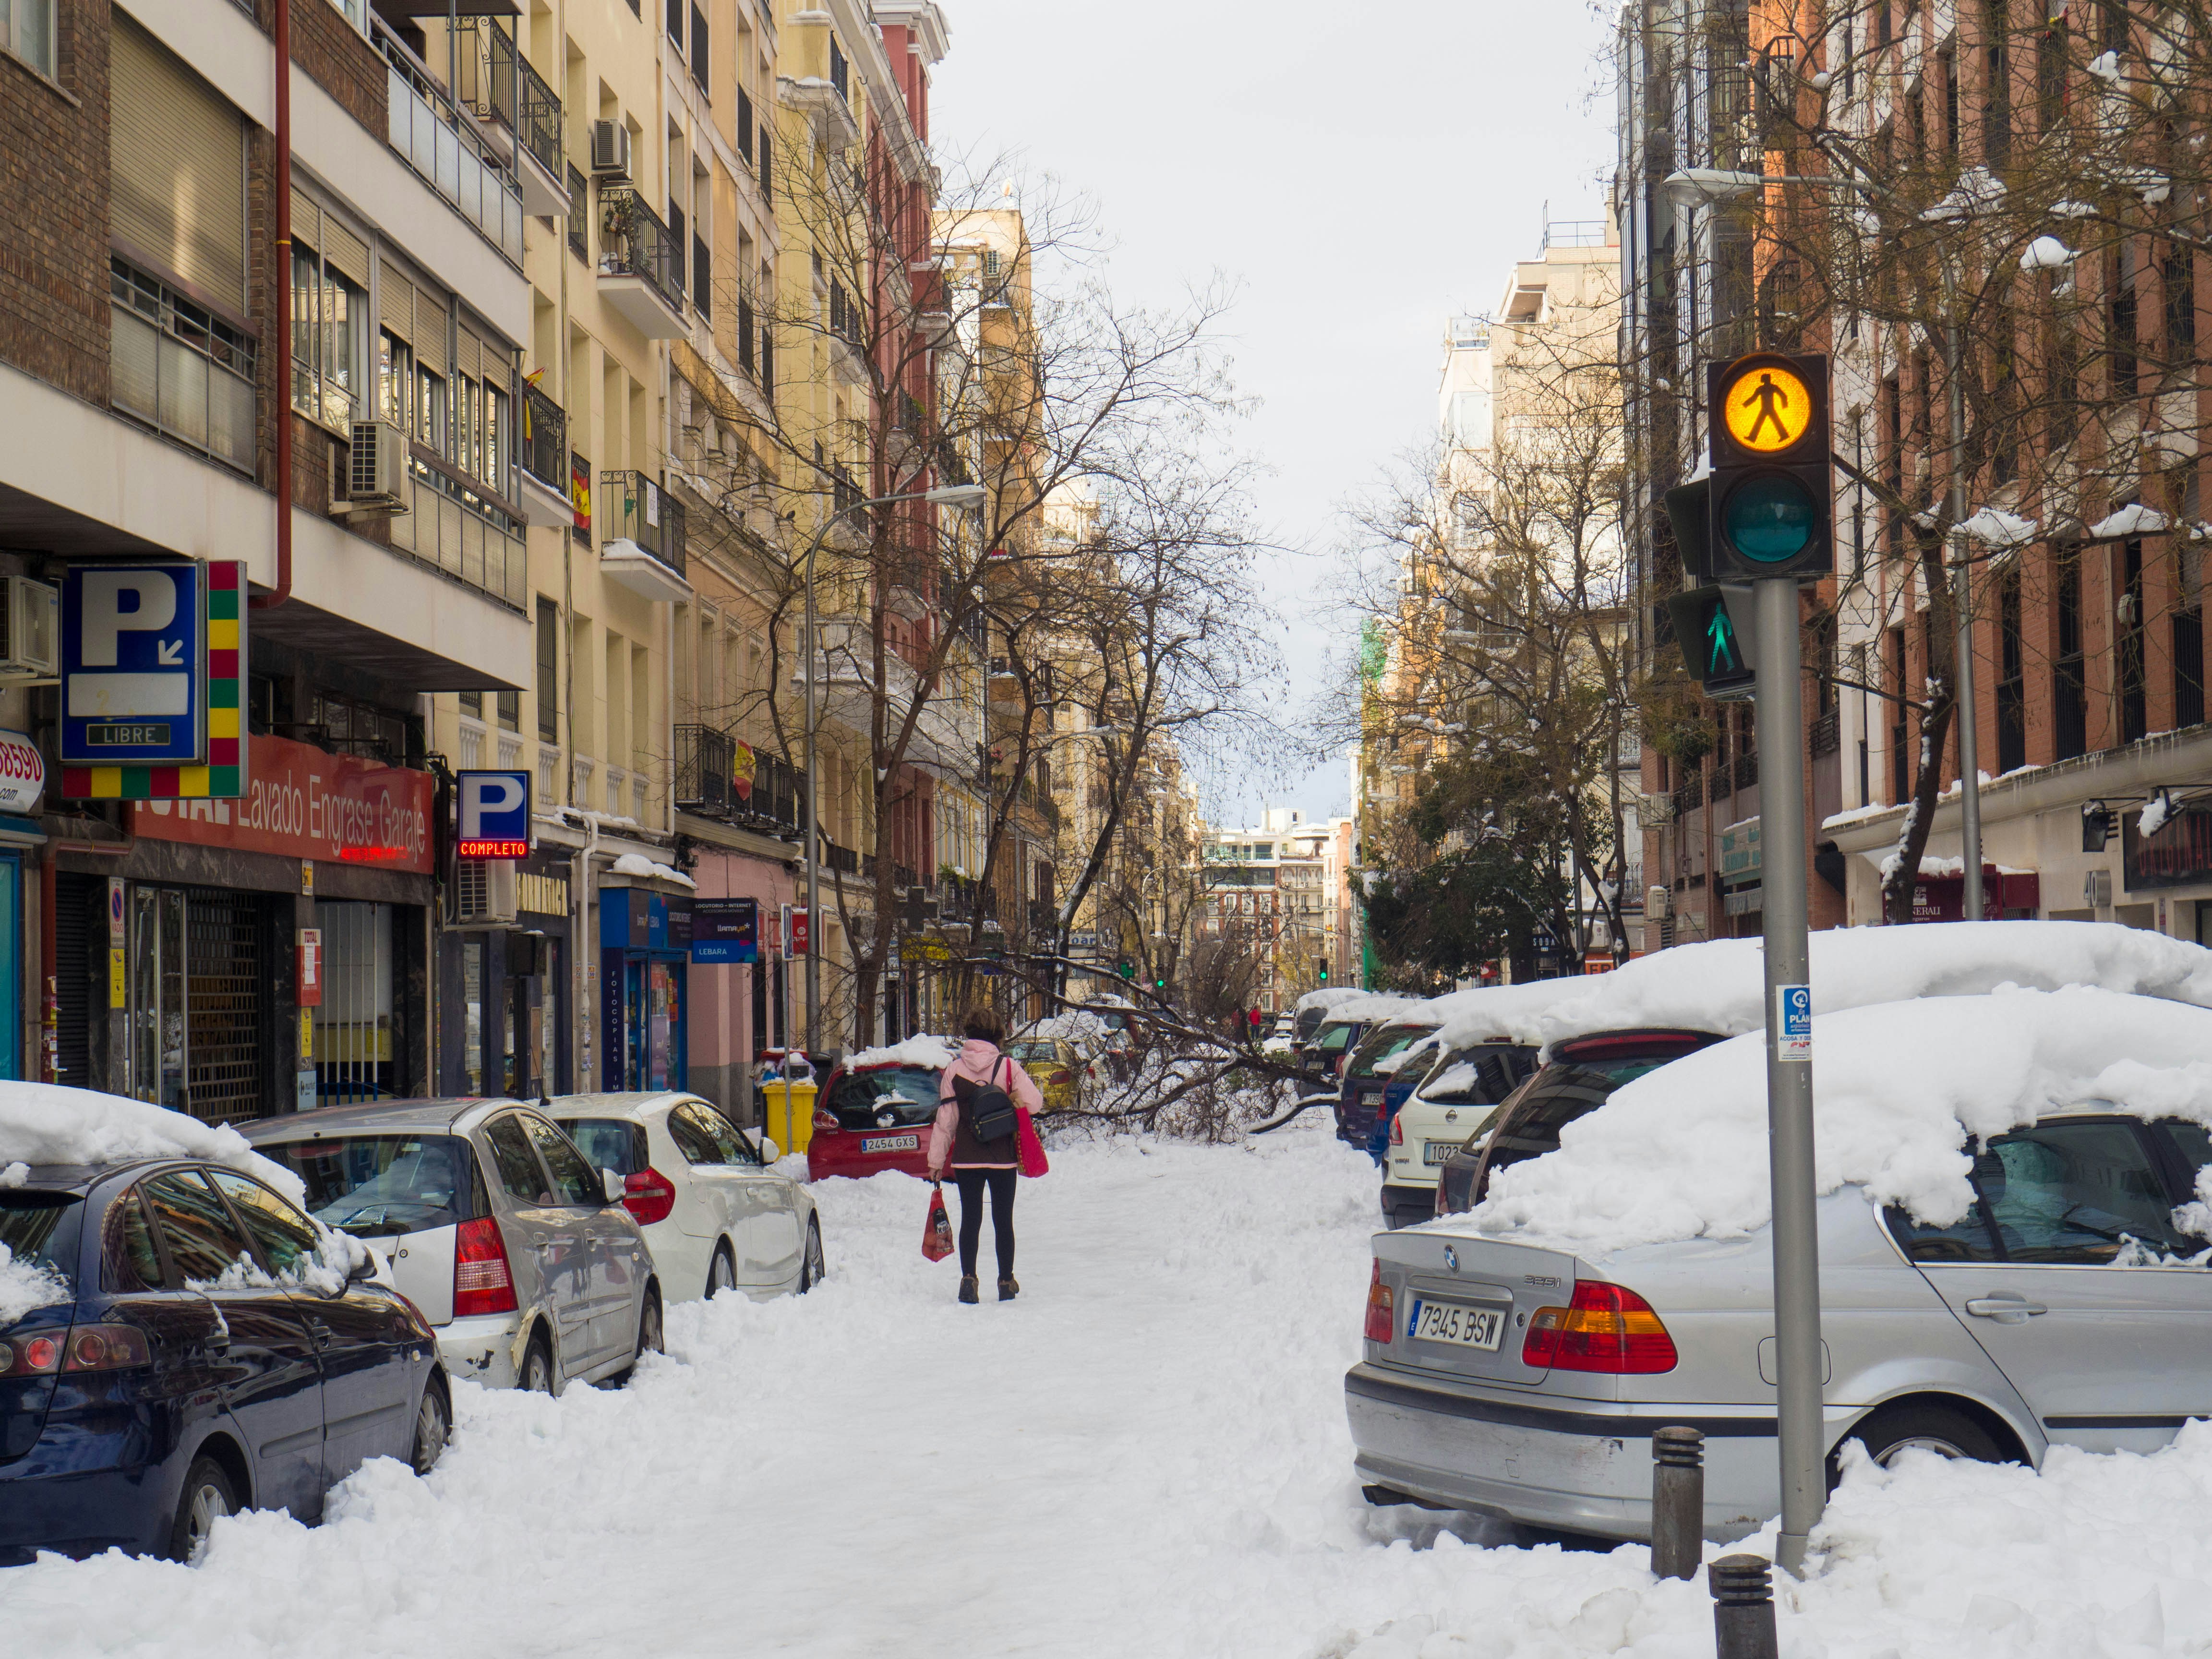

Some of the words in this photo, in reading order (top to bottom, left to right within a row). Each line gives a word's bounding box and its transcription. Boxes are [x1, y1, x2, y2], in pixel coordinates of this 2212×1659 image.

[82, 571, 176, 666] P
[104, 727, 156, 743] LIBRE
[0, 741, 42, 781] 8590
[462, 776, 524, 837] P
[310, 774, 373, 856] Engrase
[380, 789, 425, 864] Garaje
[461, 843, 525, 854] COMPLETO
[304, 931, 317, 943] TOTAL
[1533, 938, 1555, 946] SODA
[1790, 1015, 1810, 1023] PLAN
[869, 1139, 893, 1149] 2454
[896, 1137, 914, 1147] GXS
[1524, 1275, 1561, 1288] 325i
[1419, 1305, 1461, 1339] 7345
[1463, 1311, 1498, 1345] BSW
